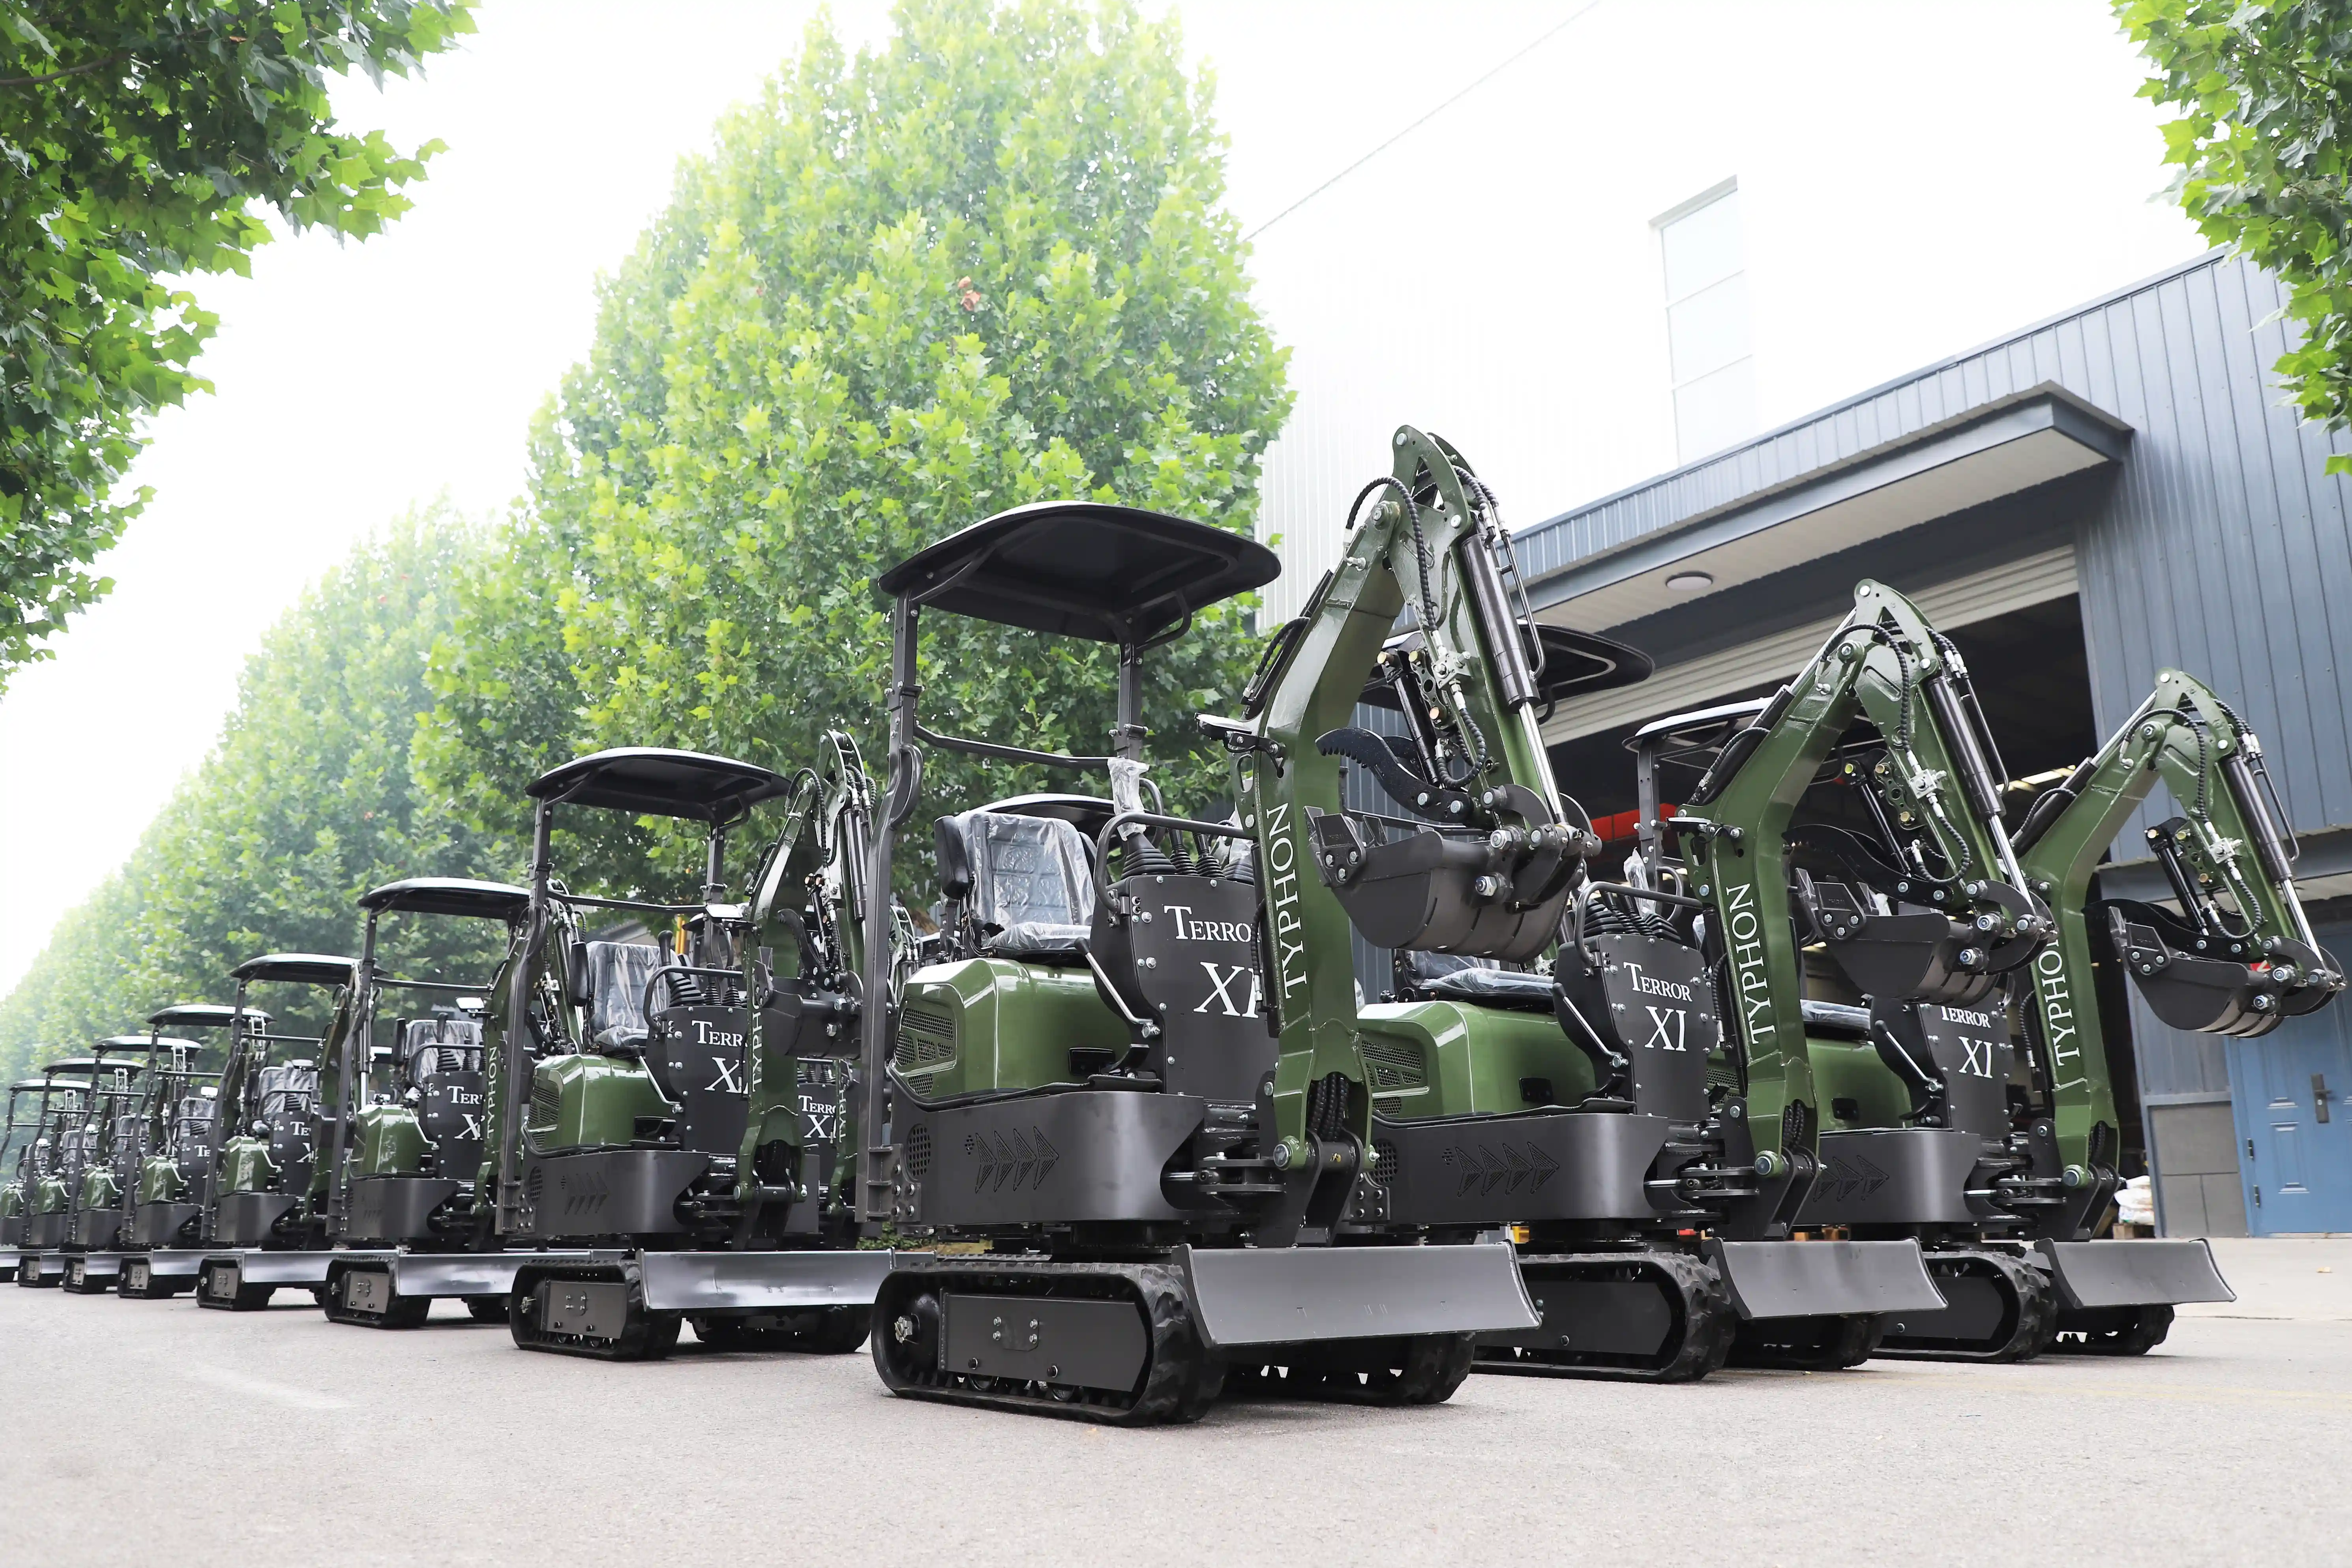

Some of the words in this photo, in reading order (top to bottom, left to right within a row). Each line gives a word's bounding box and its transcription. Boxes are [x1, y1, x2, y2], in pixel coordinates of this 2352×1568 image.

[1164, 905, 1261, 942] TERRO
[1266, 802, 1307, 999] TYPHON
[1623, 961, 1693, 1002] TERROR
[1726, 883, 1776, 1044] TYPHON
[1644, 1006, 1687, 1052] XI
[2038, 939, 2081, 1066] TYPHO
[1958, 1036, 1993, 1079] XI
[487, 1046, 497, 1139] TYPHON
